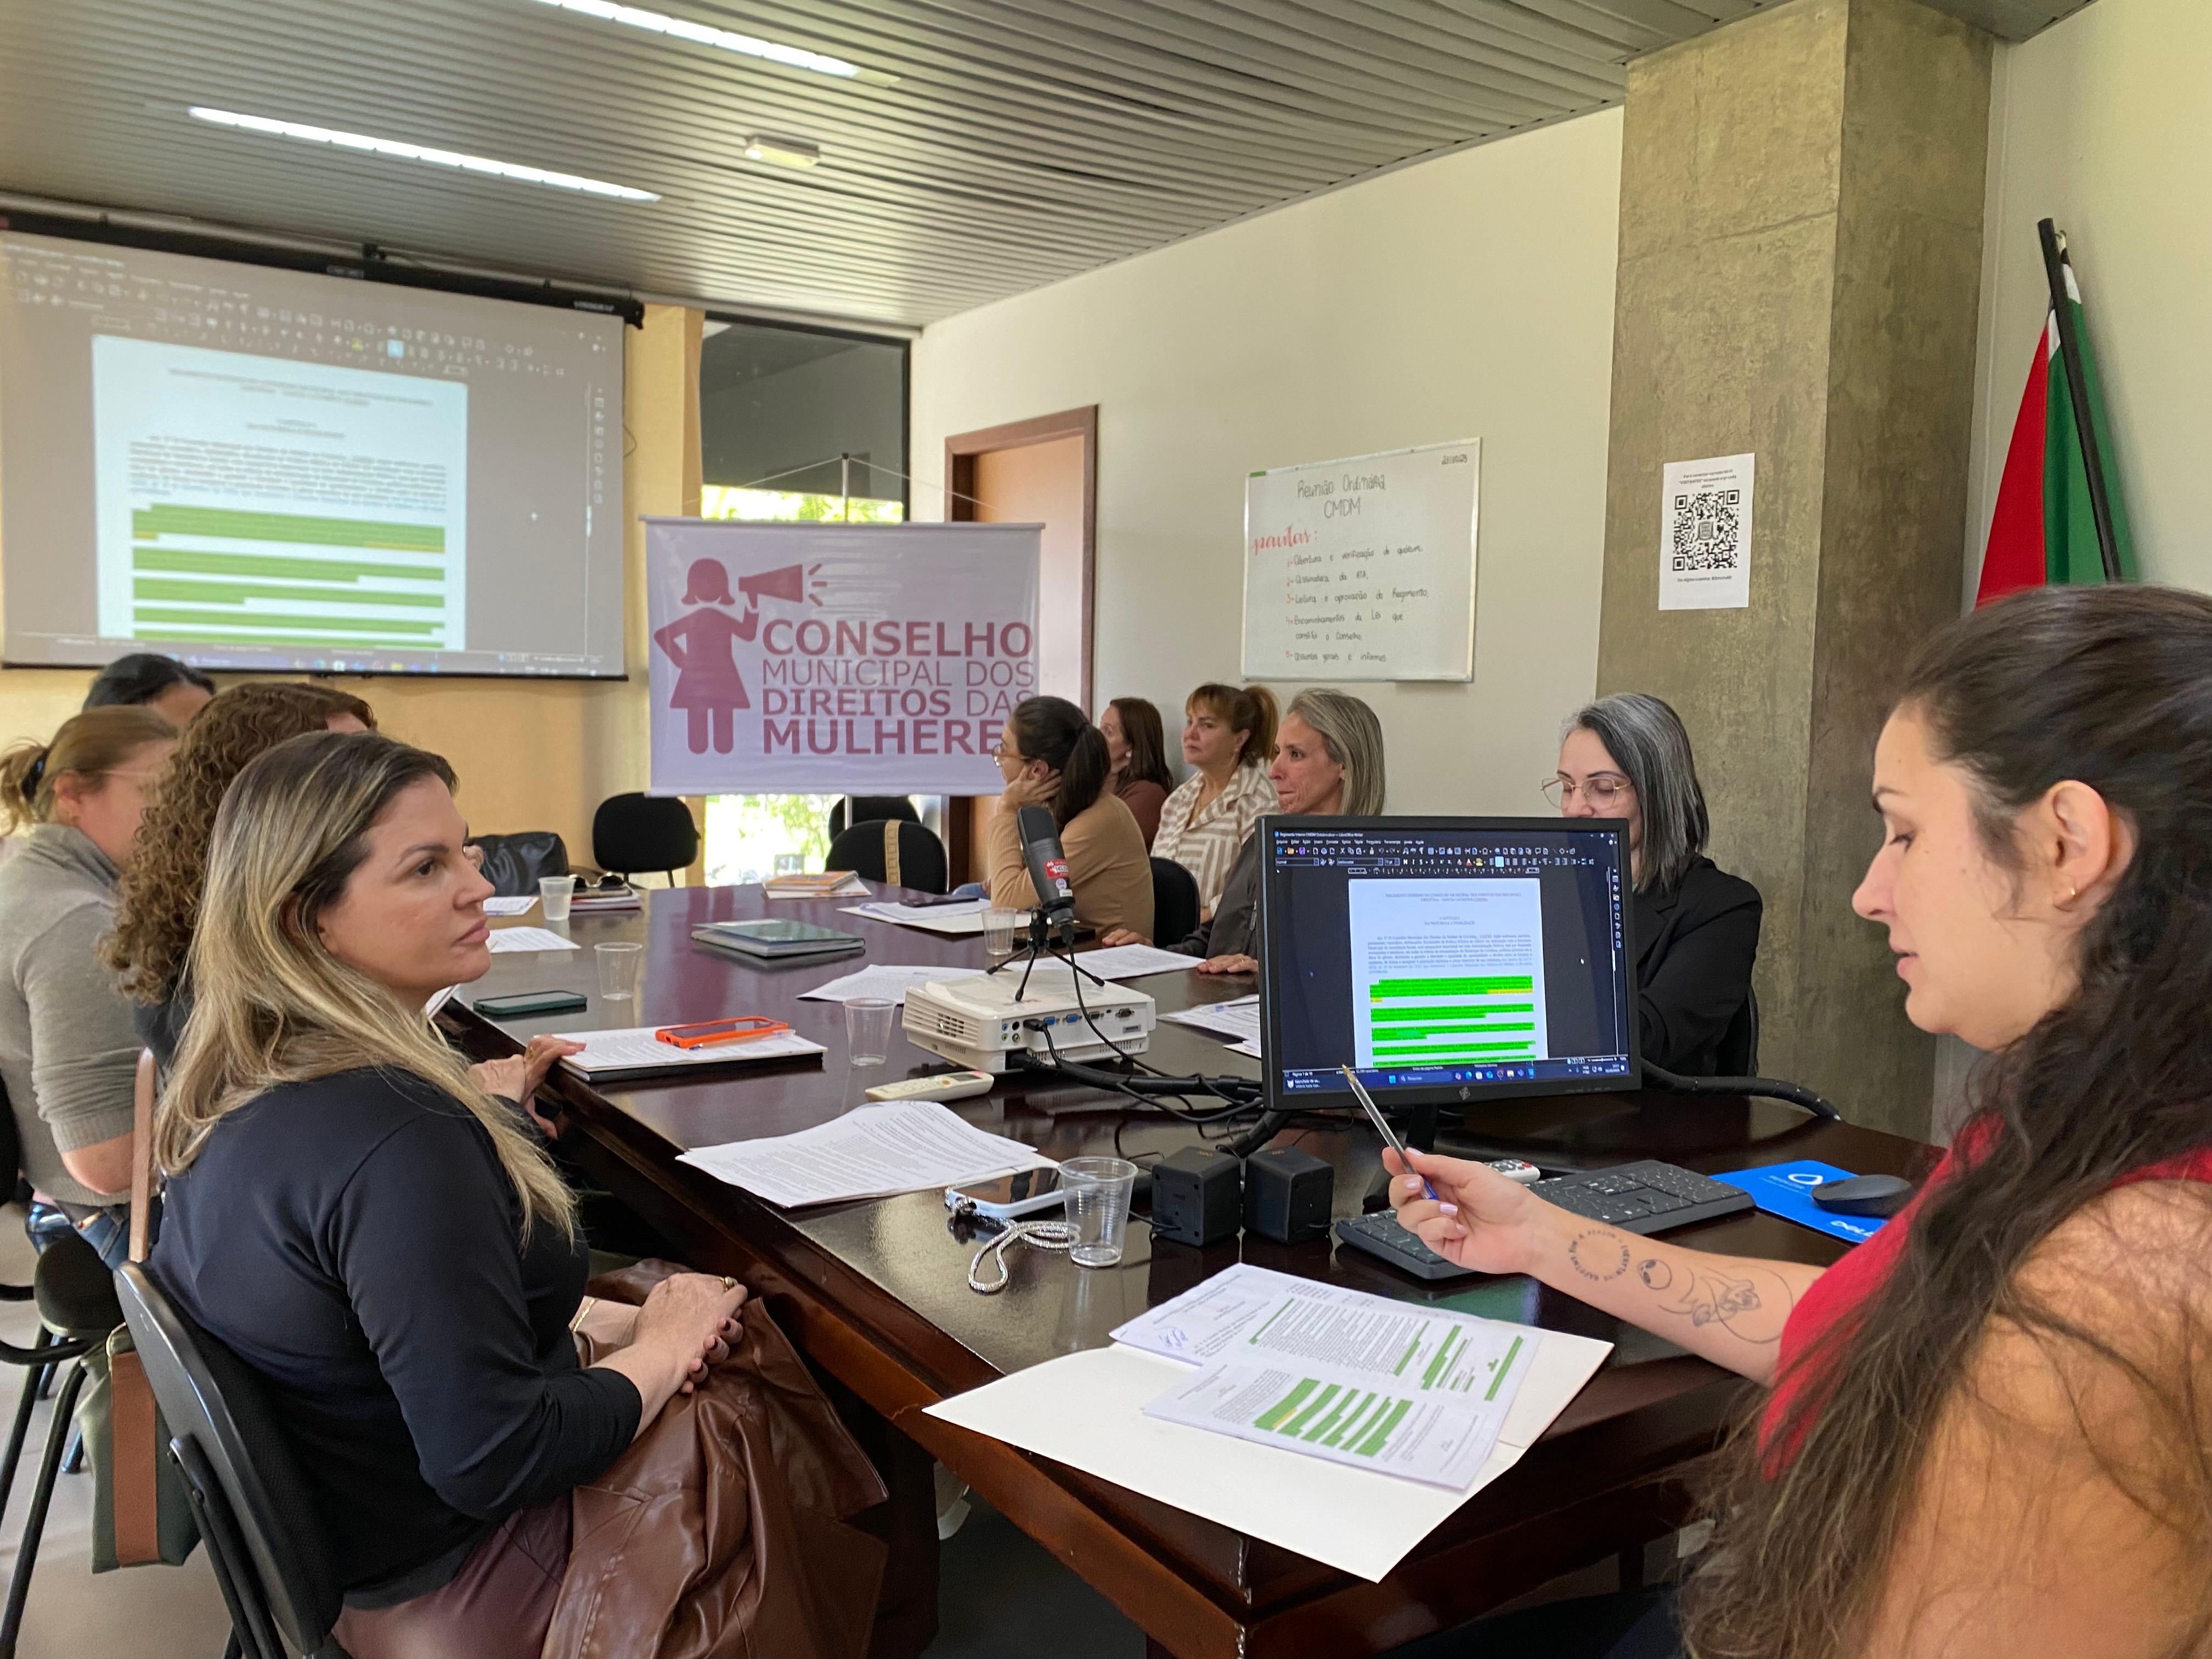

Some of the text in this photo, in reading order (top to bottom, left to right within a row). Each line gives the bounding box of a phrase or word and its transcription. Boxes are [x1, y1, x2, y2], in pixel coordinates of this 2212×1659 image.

[1324, 496, 1361, 518] CMDM
[763, 619, 1032, 657] CONSELHO
[763, 659, 1034, 687] MUNICIPAL DOS
[763, 689, 951, 717] DIREITOS
[763, 719, 1004, 755] MULHERE
